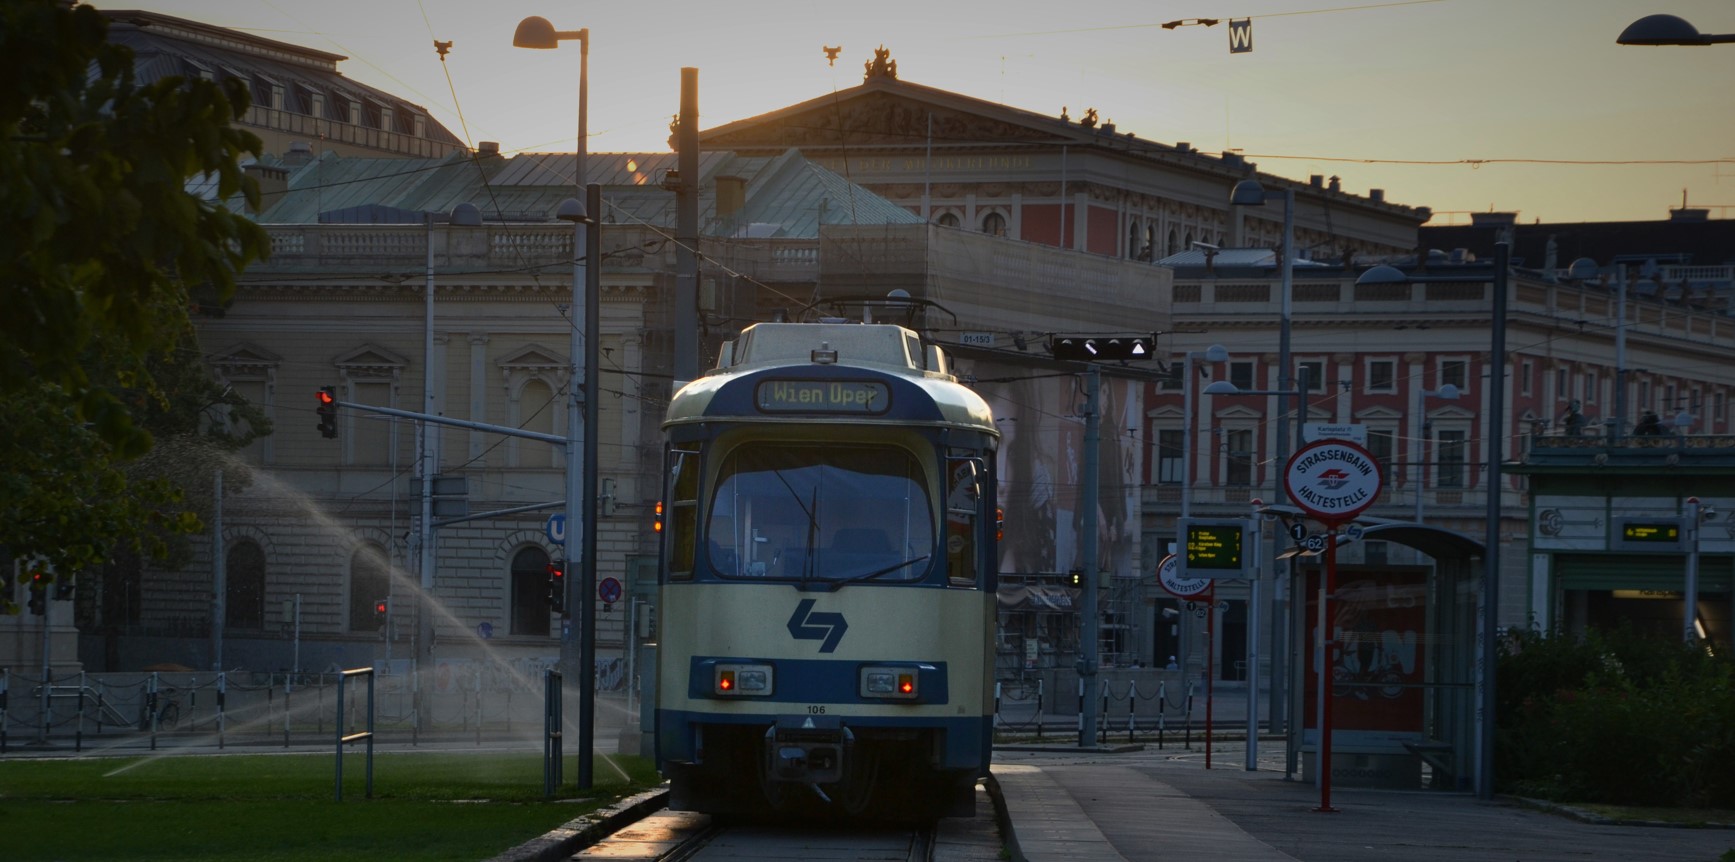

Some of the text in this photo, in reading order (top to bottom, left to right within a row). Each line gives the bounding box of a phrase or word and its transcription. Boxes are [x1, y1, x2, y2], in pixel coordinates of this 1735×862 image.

[1230, 26, 1251, 48] W
[963, 335, 991, 344] 01-15/3
[774, 381, 878, 406] Wien Oper
[1296, 449, 1373, 476] STRASSENBAHN
[1298, 485, 1368, 509] HALTESTELLE
[551, 520, 565, 541] U
[1294, 525, 1302, 539] 1
[1307, 538, 1322, 550] 62
[1166, 579, 1206, 593] HALTESTELLE
[807, 705, 826, 714] 106
